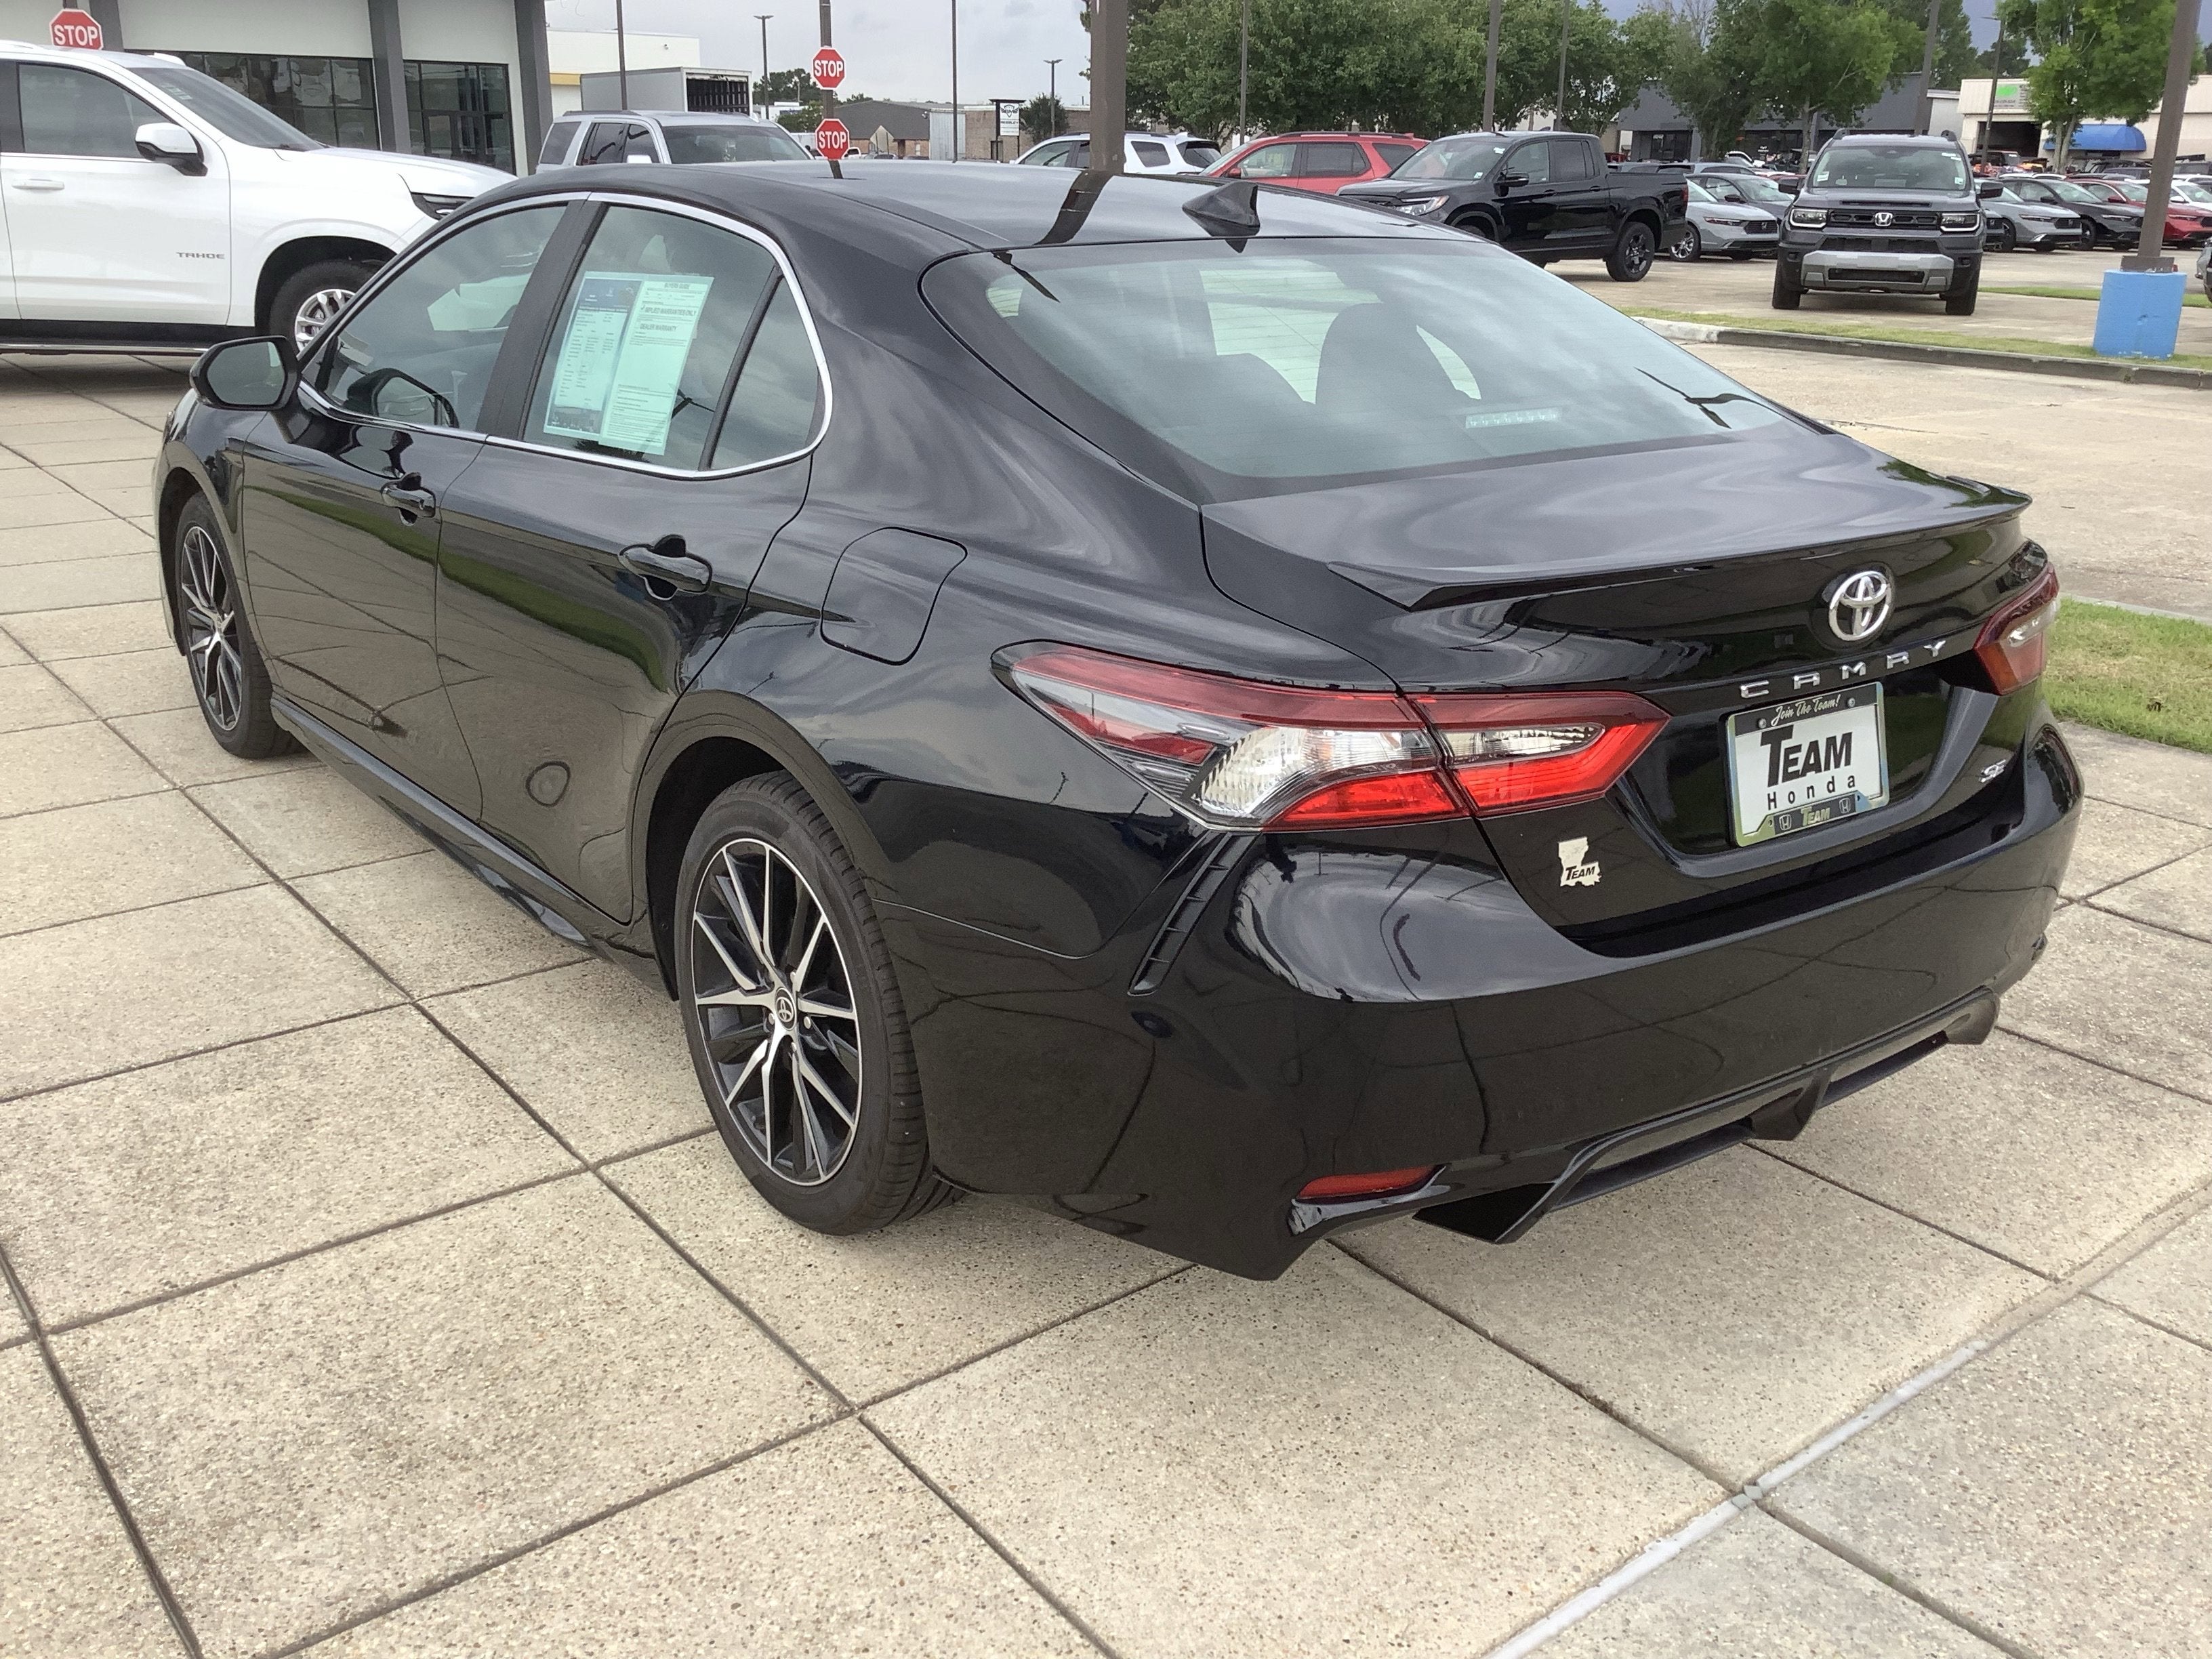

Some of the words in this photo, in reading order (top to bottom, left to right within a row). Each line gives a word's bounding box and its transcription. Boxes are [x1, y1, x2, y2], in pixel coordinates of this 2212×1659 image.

[54, 24, 98, 46] STOP
[814, 60, 843, 77] STOP
[819, 131, 846, 149] STOP
[1740, 640, 1946, 699] CAMRY
[1771, 705, 1795, 726] Join
[1795, 701, 1811, 717] The
[1812, 694, 1841, 712] Team!
[1760, 724, 1853, 787] TEAM
[1980, 759, 2006, 783] SE
[1767, 775, 1856, 811] Honda
[1801, 806, 1830, 826] TEAM
[1565, 865, 1595, 881] TEAM
